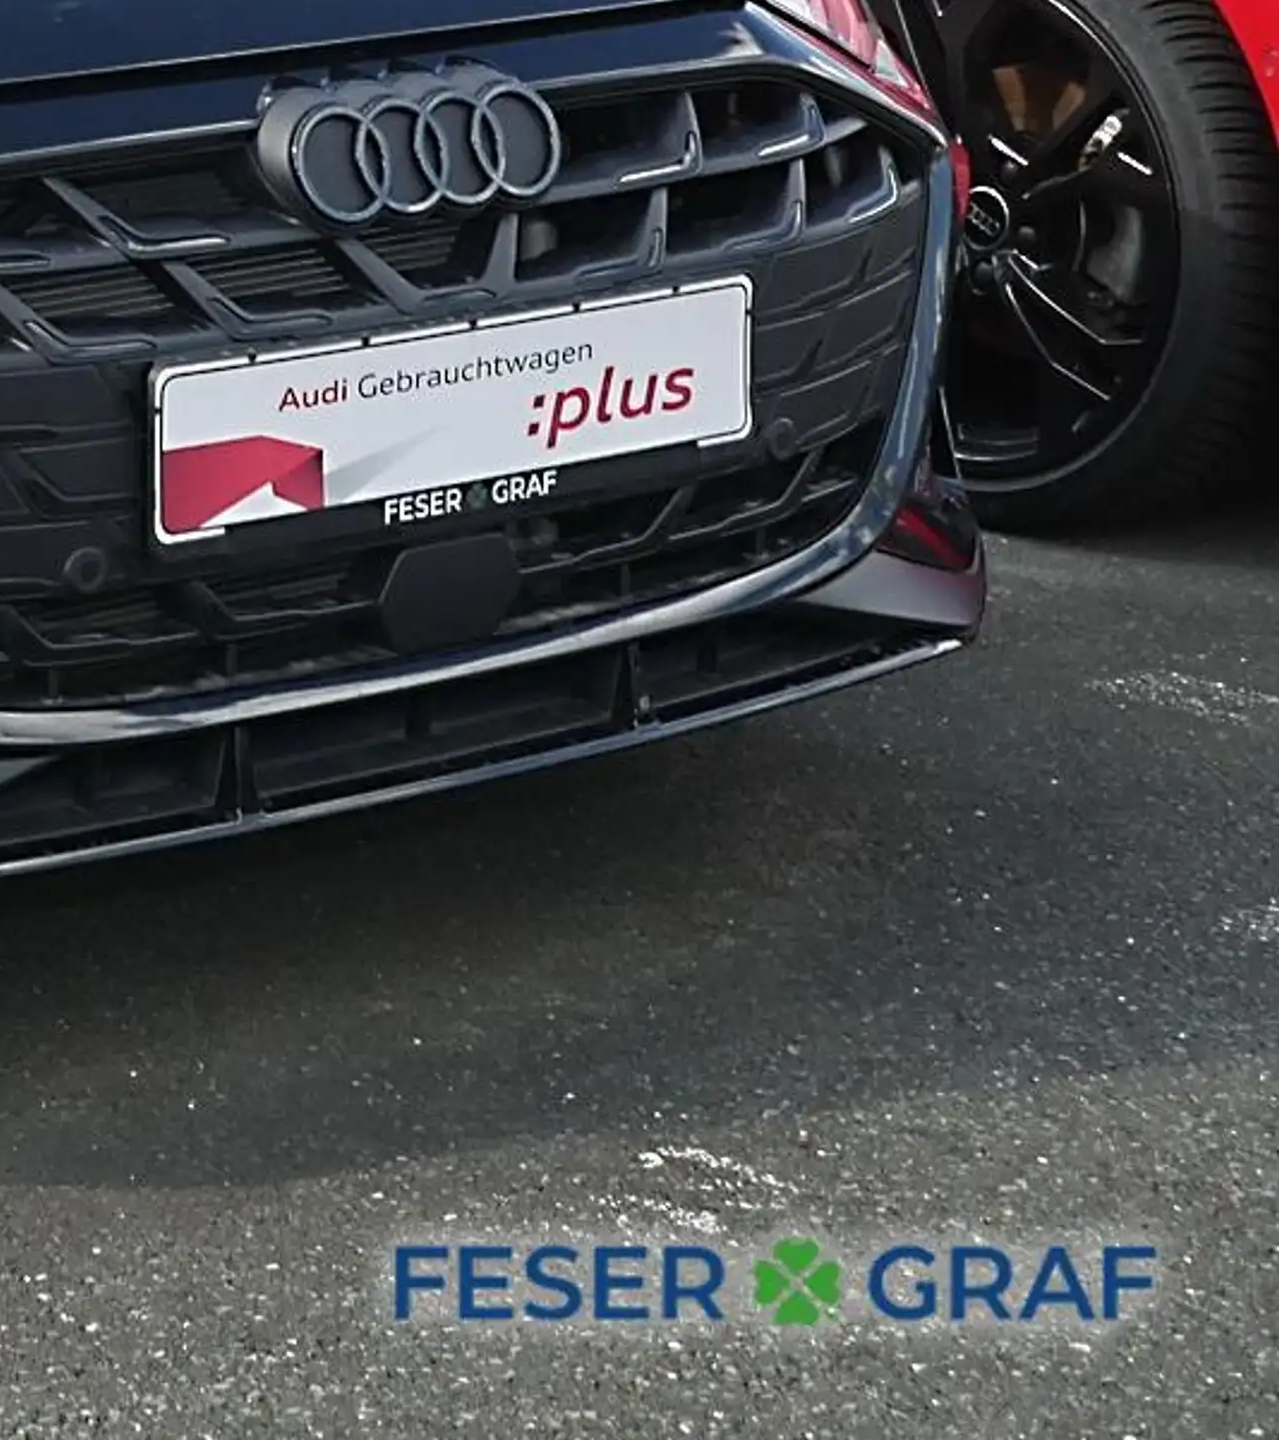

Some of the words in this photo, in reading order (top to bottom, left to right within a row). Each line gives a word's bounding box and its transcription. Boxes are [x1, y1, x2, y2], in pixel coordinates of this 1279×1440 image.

[278, 377, 349, 412] Audi
[357, 342, 594, 400] Gebrauchtwagen
[527, 365, 695, 449] :plus
[384, 486, 463, 526] FESER
[491, 469, 558, 504] GRAF
